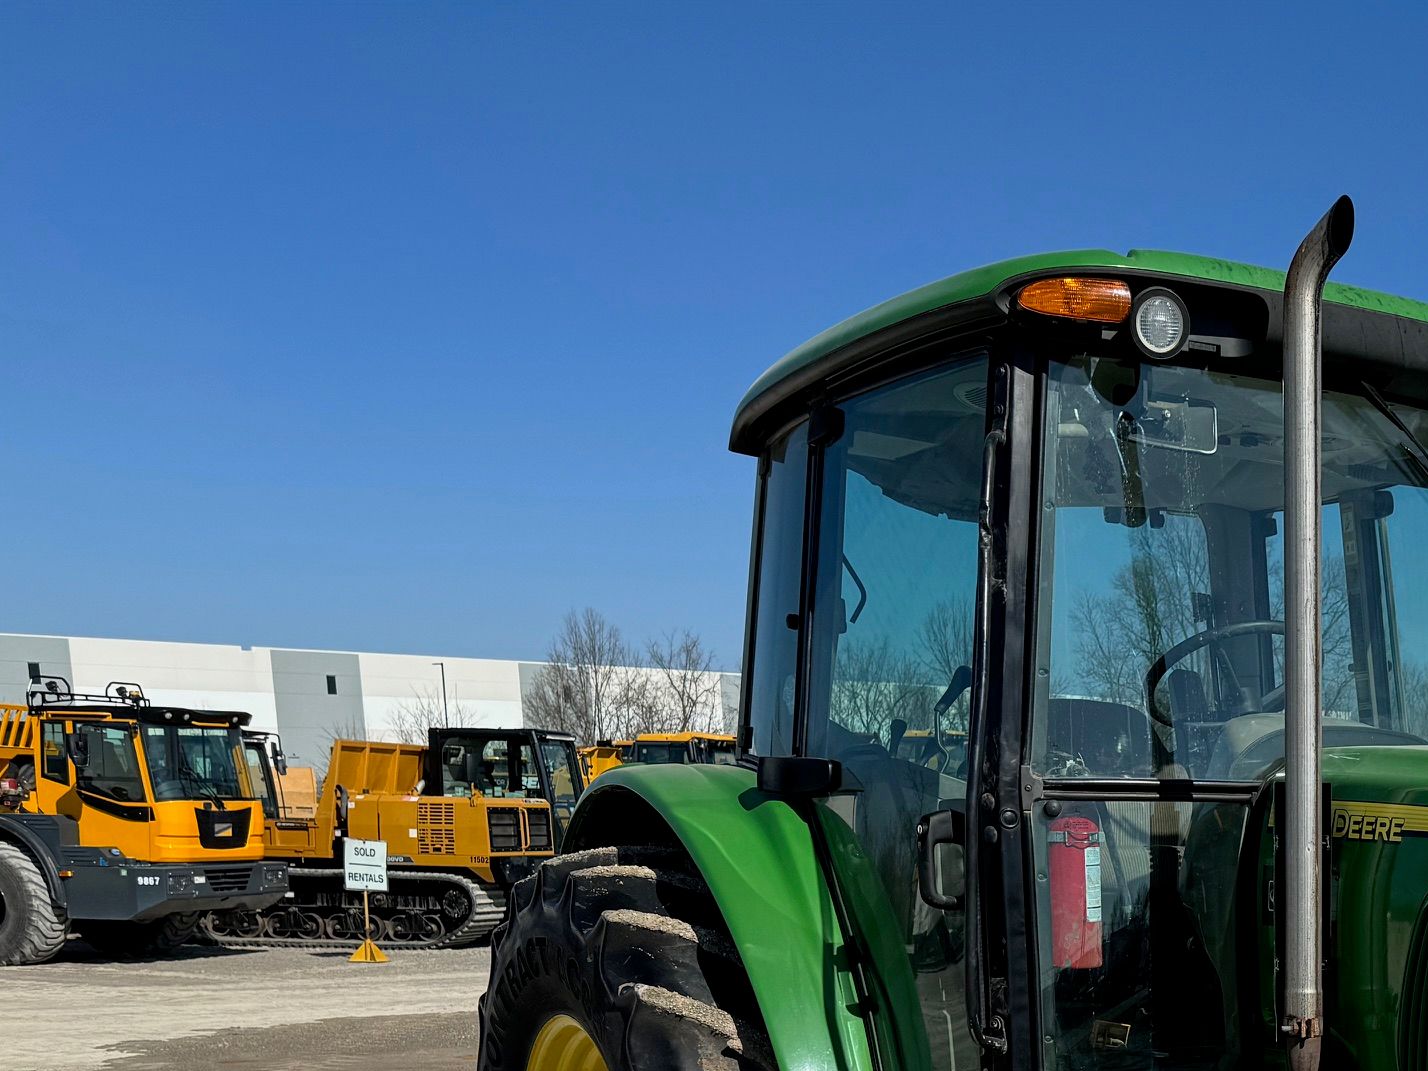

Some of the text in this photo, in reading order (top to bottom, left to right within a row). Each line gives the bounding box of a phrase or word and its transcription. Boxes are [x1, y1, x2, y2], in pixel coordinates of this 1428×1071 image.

[1331, 808, 1405, 842] DEERE
[353, 847, 376, 858] SOLD
[470, 856, 489, 864] 11502
[137, 876, 160, 886] 9867
[348, 872, 384, 883] RENTALS
